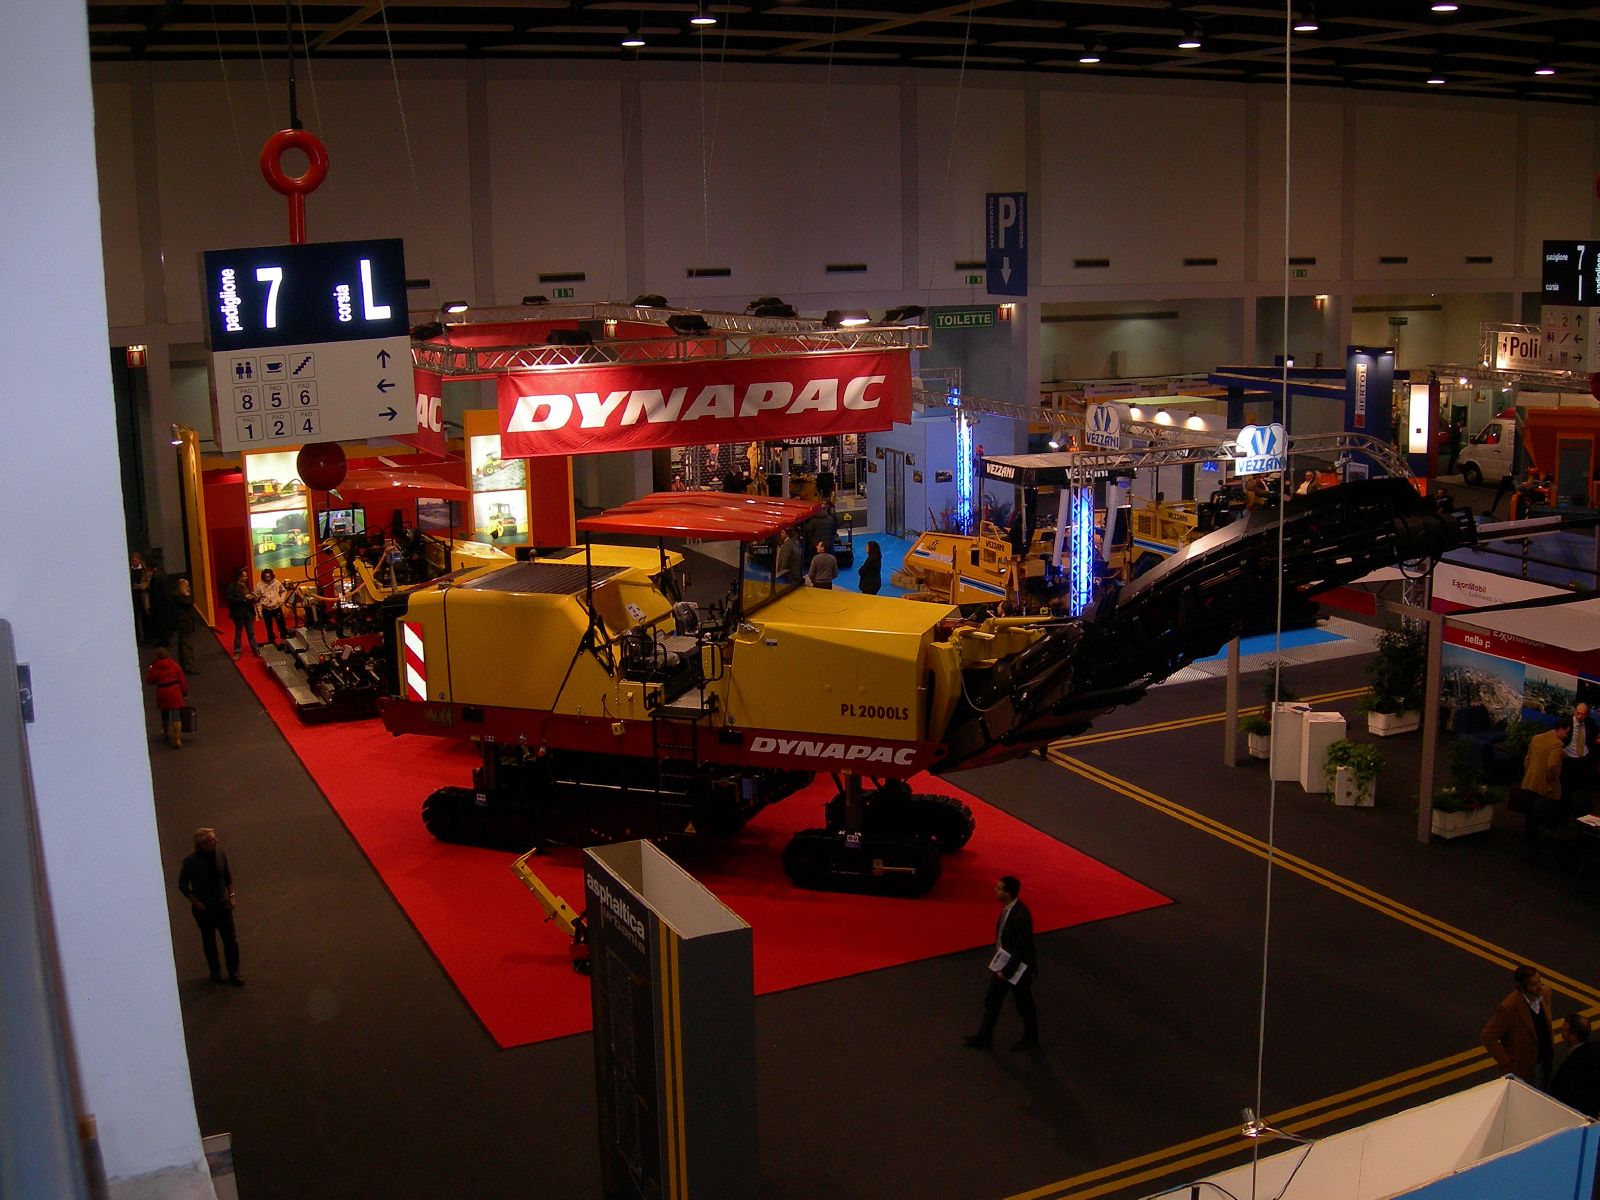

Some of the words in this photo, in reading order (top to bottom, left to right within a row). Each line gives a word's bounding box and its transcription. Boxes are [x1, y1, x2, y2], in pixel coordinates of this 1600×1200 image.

[999, 196, 1017, 249] P
[1577, 245, 1586, 270] 7
[256, 267, 283, 328] 7
[360, 259, 391, 320] L
[220, 268, 243, 332] padiglione
[333, 284, 352, 322] corsia
[938, 313, 991, 326] TOILETTE
[1510, 336, 1541, 358] Poli
[242, 394, 253, 410] 8
[271, 392, 282, 408] 5
[300, 389, 311, 405] 6
[506, 375, 886, 433] DYNAPAC
[245, 424, 253, 439] 1
[273, 420, 285, 435] 2
[303, 418, 313, 433] 4
[1086, 431, 1119, 449] VEZZANI
[986, 462, 1015, 479] VEZZANI
[1452, 579, 1487, 593] ExxonMobil
[1464, 635, 1483, 645] nella
[750, 736, 917, 765] DYNAPAC
[586, 872, 646, 941] asphaltica
